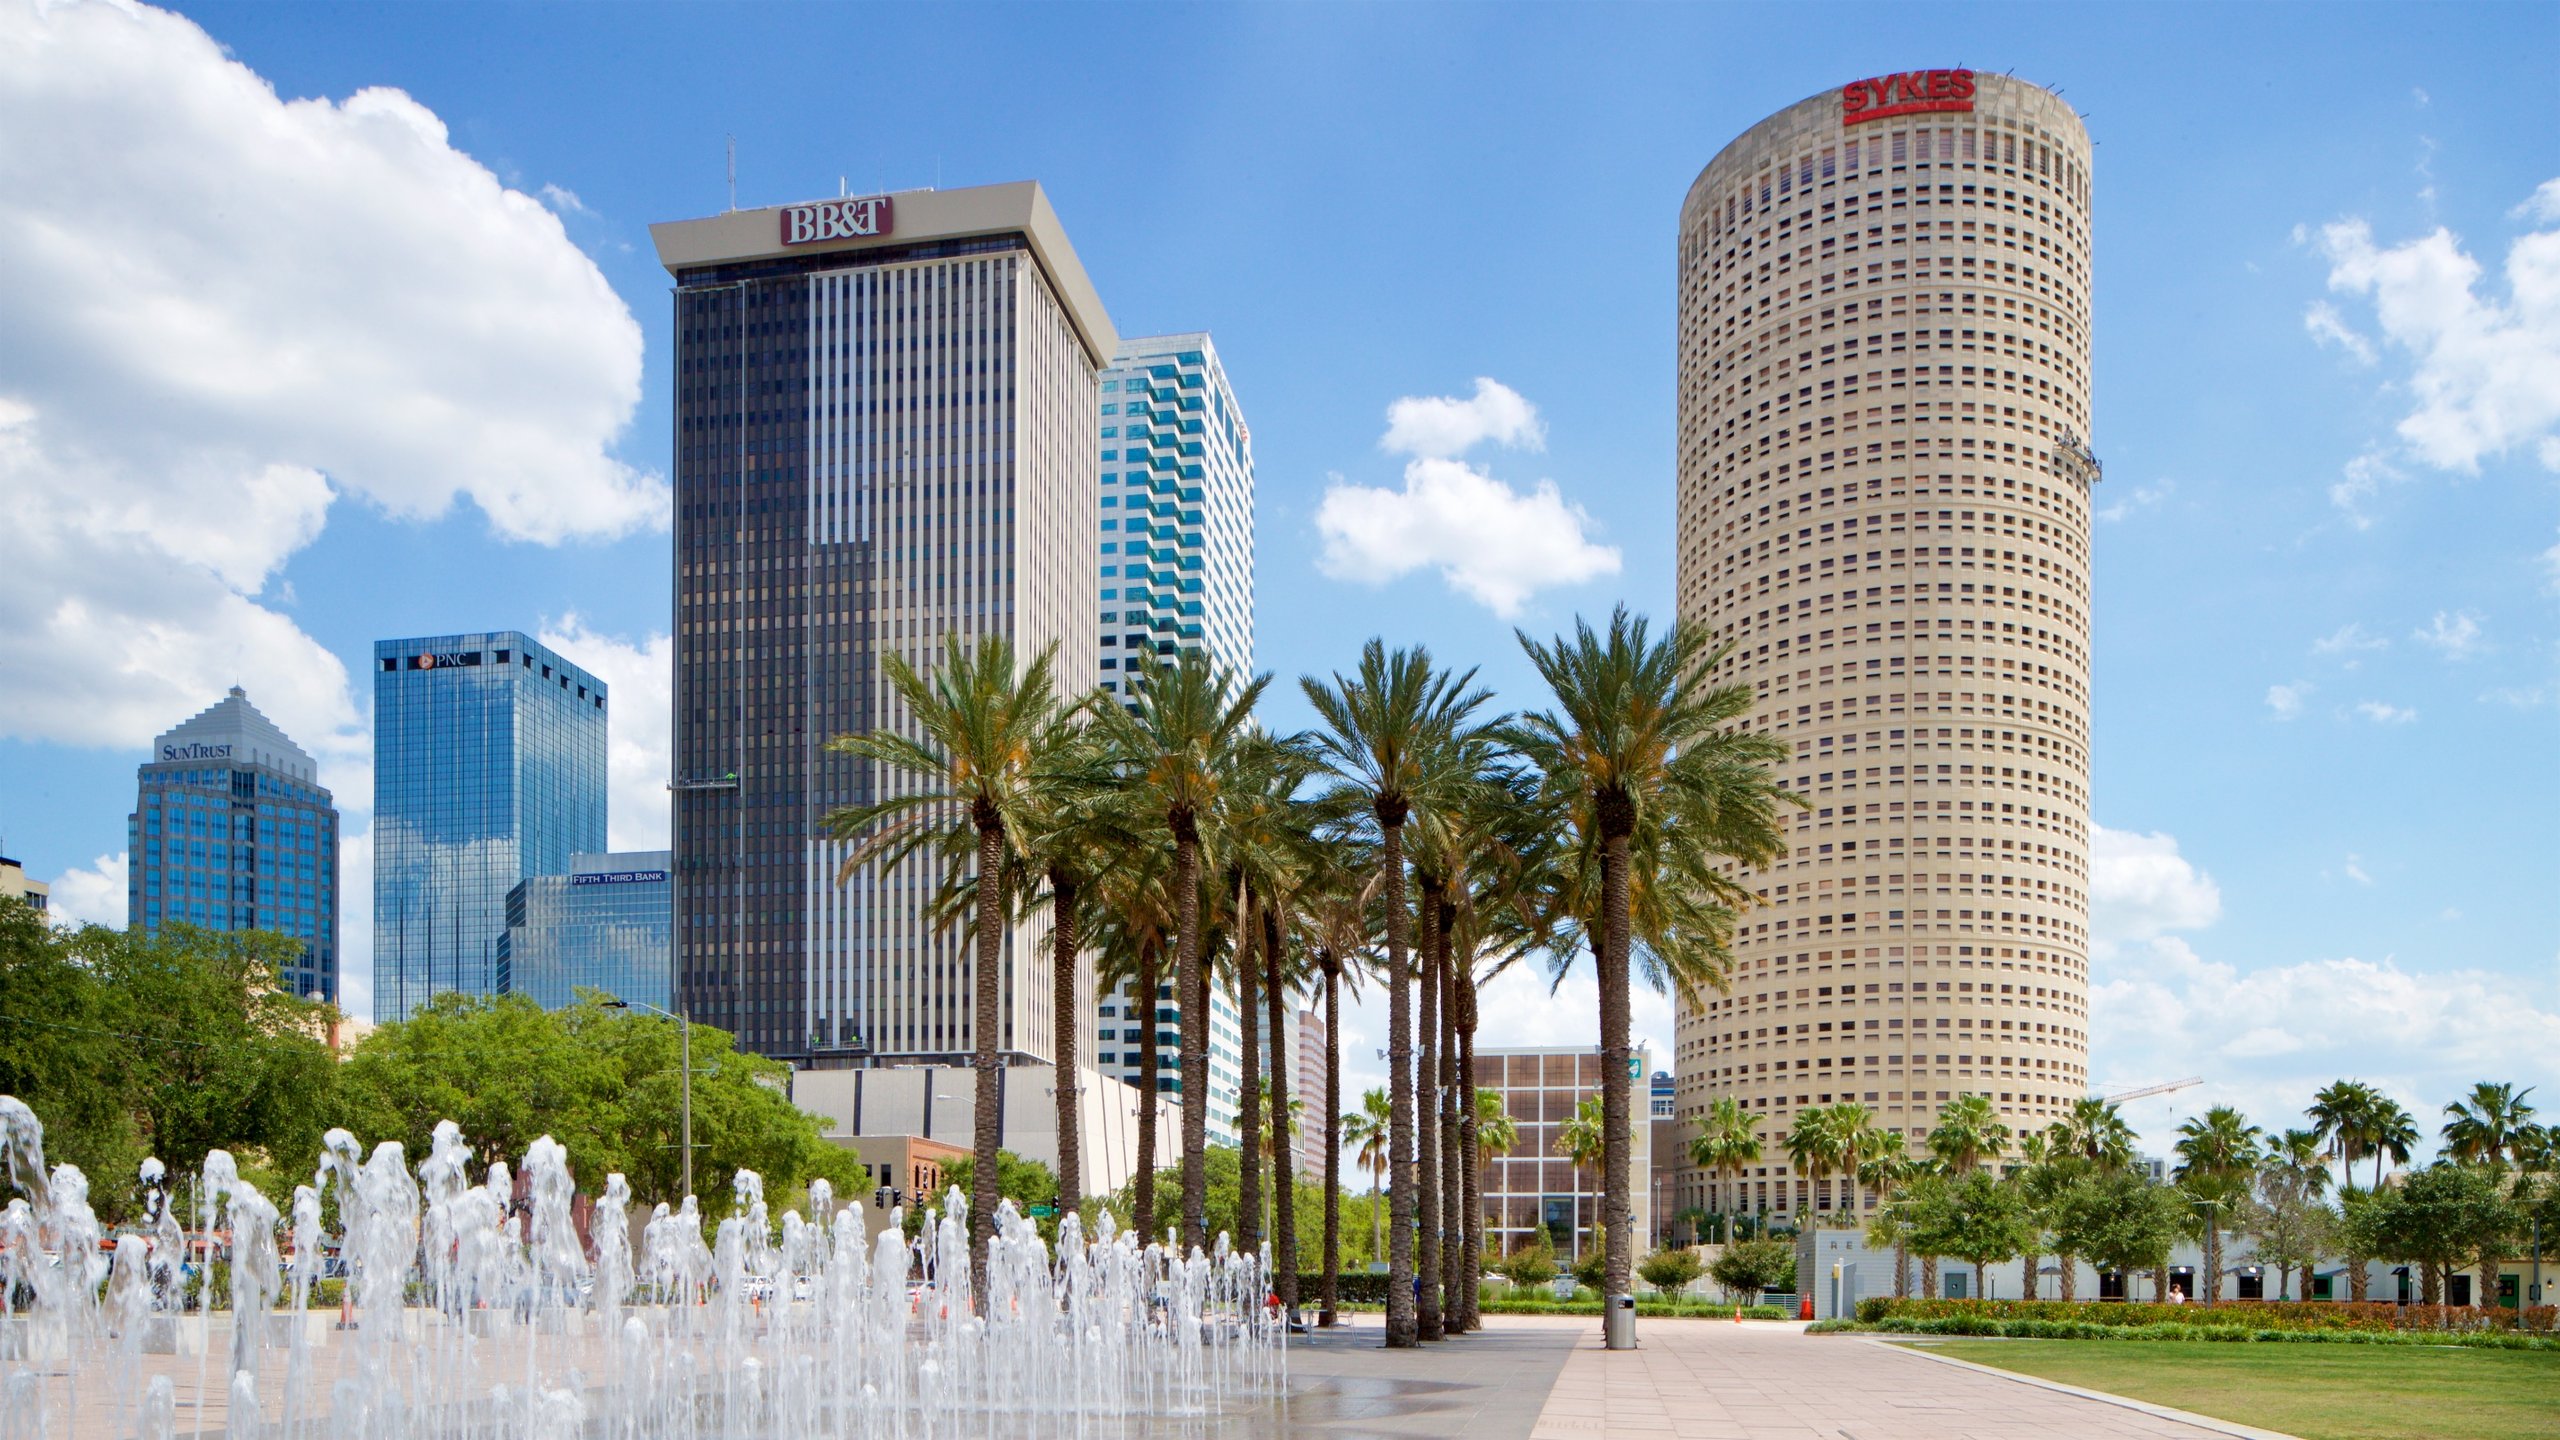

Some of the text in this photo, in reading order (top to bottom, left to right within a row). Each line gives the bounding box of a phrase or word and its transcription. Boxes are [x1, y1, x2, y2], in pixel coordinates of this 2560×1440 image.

[1843, 69, 1975, 111] SYKES
[787, 199, 886, 243] BB&T
[436, 653, 467, 667] PNC
[573, 872, 662, 884] FIFTH THIRD BANK
